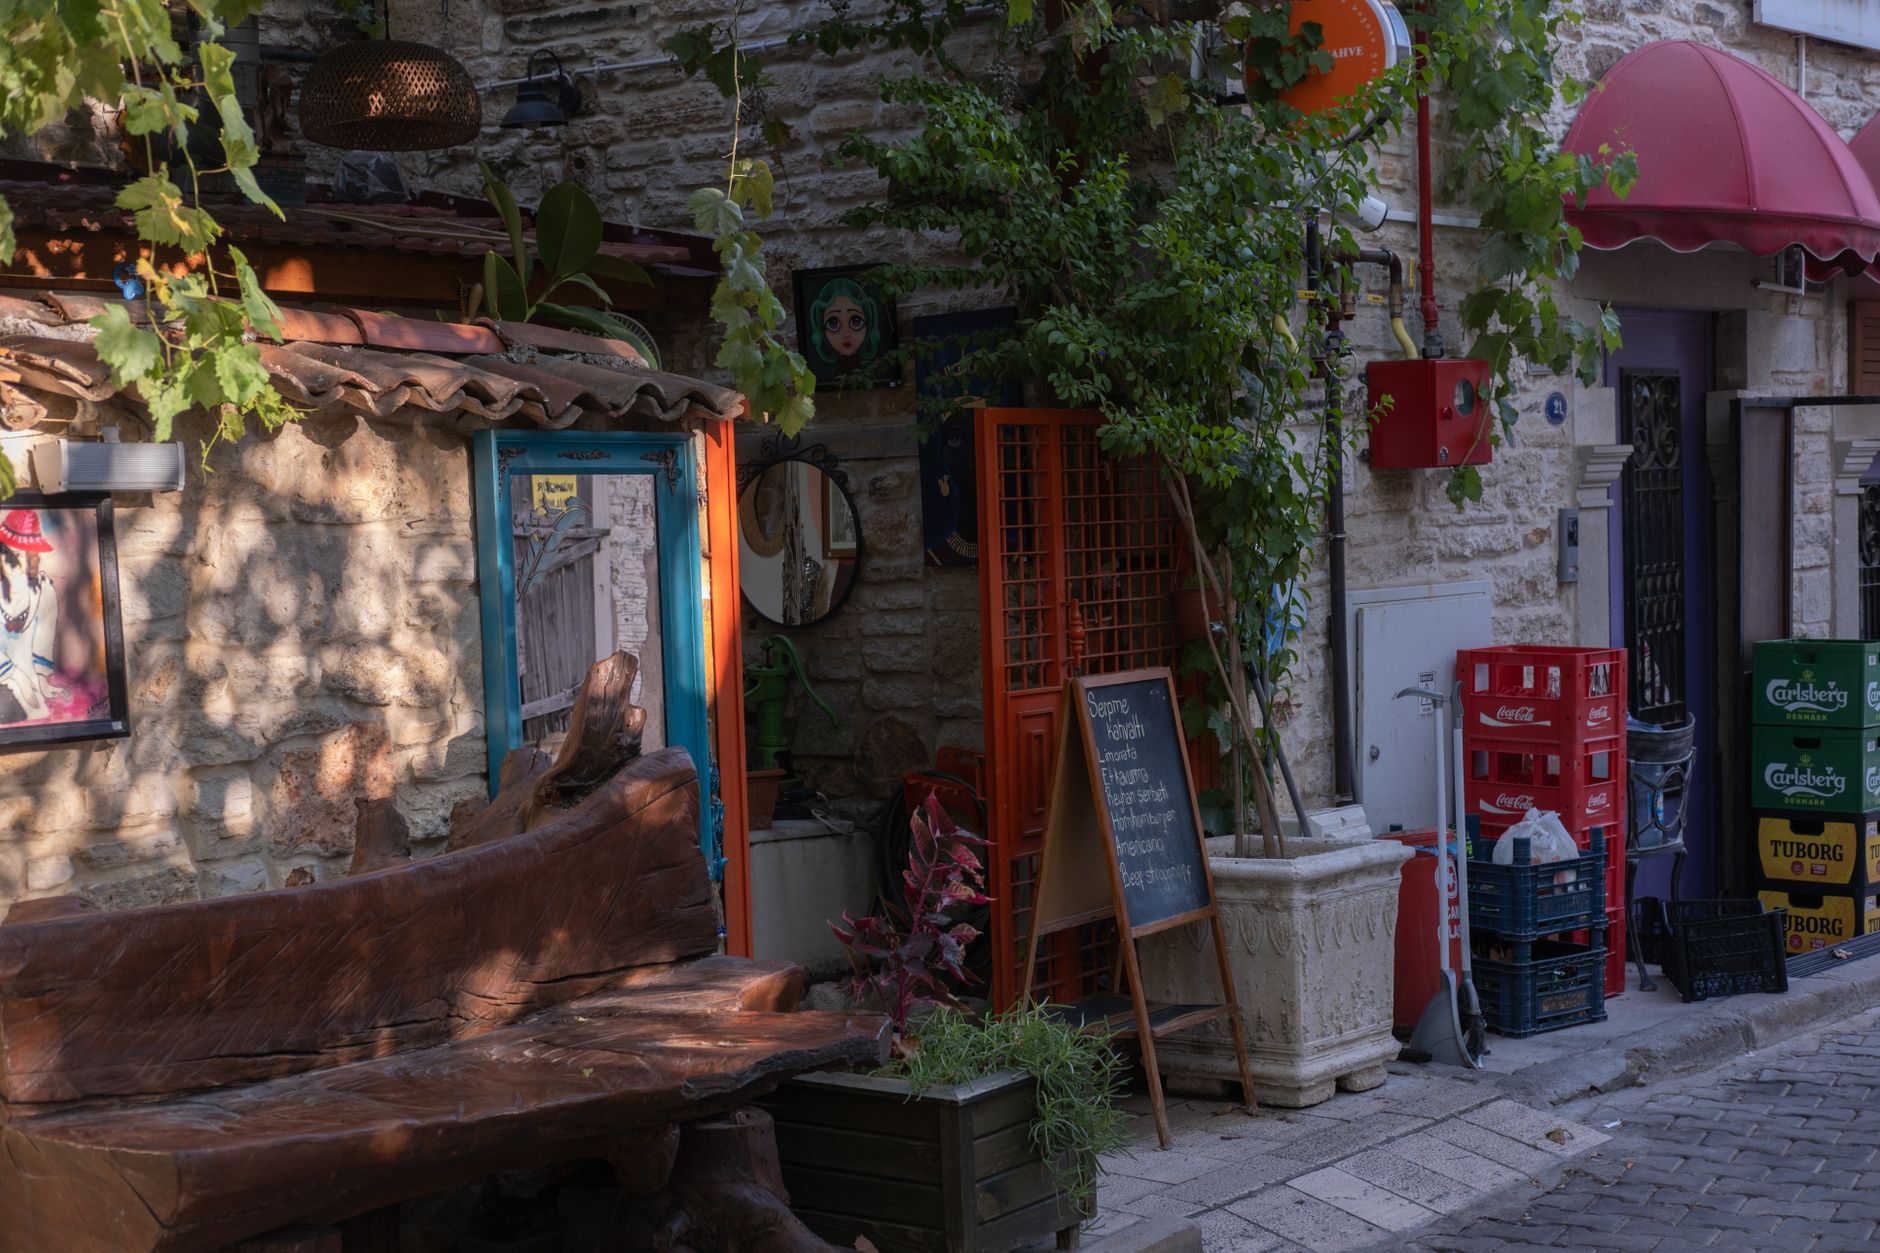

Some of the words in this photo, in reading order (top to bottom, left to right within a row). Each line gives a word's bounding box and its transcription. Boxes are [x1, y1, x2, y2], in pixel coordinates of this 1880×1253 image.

[1330, 46, 1364, 58] AHVE
[1087, 691, 1130, 721] Serpme
[1766, 679, 1848, 712] Carlsberg
[1786, 713, 1828, 721] DENMARK
[1096, 743, 1137, 763] Limonata
[1764, 762, 1846, 797] Carlsberg
[1784, 797, 1826, 806] DENMARK
[1115, 835, 1164, 856] Americano
[1771, 839, 1844, 862] TUBORG
[1120, 862, 1144, 890] Beef
